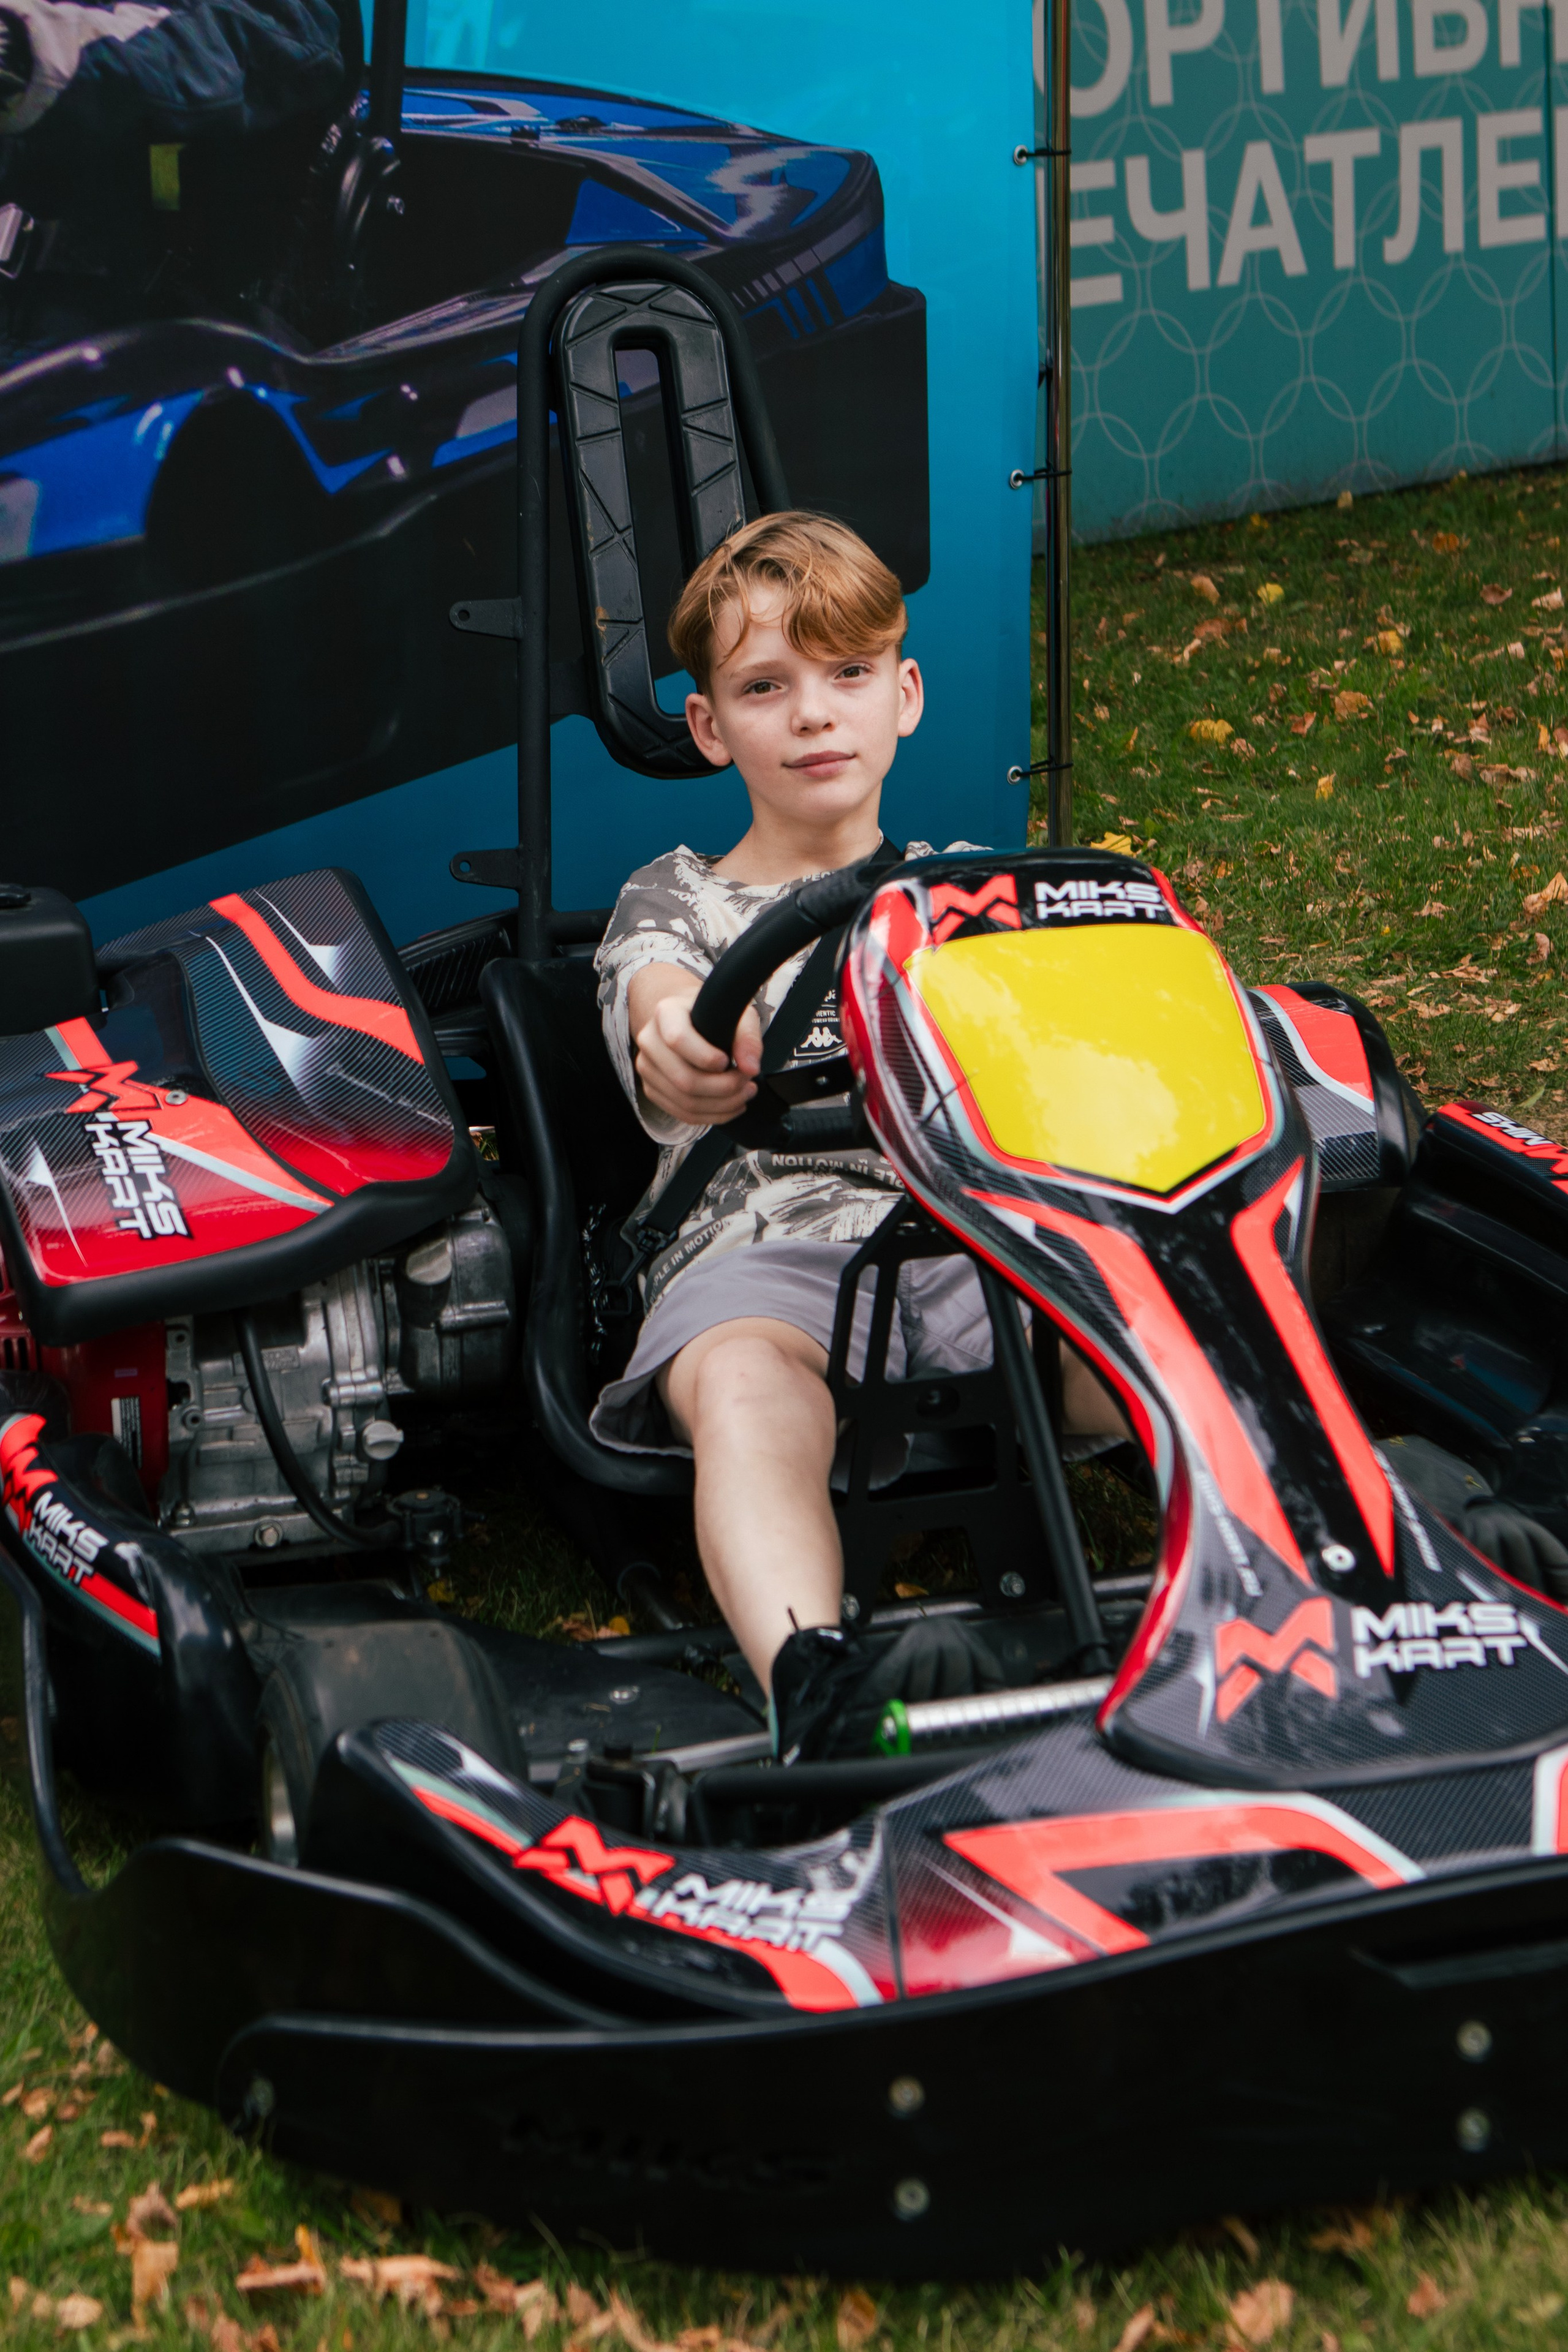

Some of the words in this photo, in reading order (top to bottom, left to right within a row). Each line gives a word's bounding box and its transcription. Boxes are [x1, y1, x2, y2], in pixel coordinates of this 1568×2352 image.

[1036, 105, 1568, 308] ЕЧАТЛЕ
[1035, 880, 1163, 902] MIKS
[1036, 900, 1164, 919] KART
[1471, 1112, 1555, 1146] MIKS
[85, 1123, 153, 1238] KART
[116, 1121, 188, 1236] MIKS
[671, 1250, 684, 1266] IN
[34, 1490, 110, 1562] MIKS
[28, 1517, 94, 1585] KART
[1350, 1600, 1519, 1644] MIKS
[1352, 1634, 1528, 1679] KART
[674, 1872, 851, 1920] MIKS
[652, 1890, 843, 1954] KART
